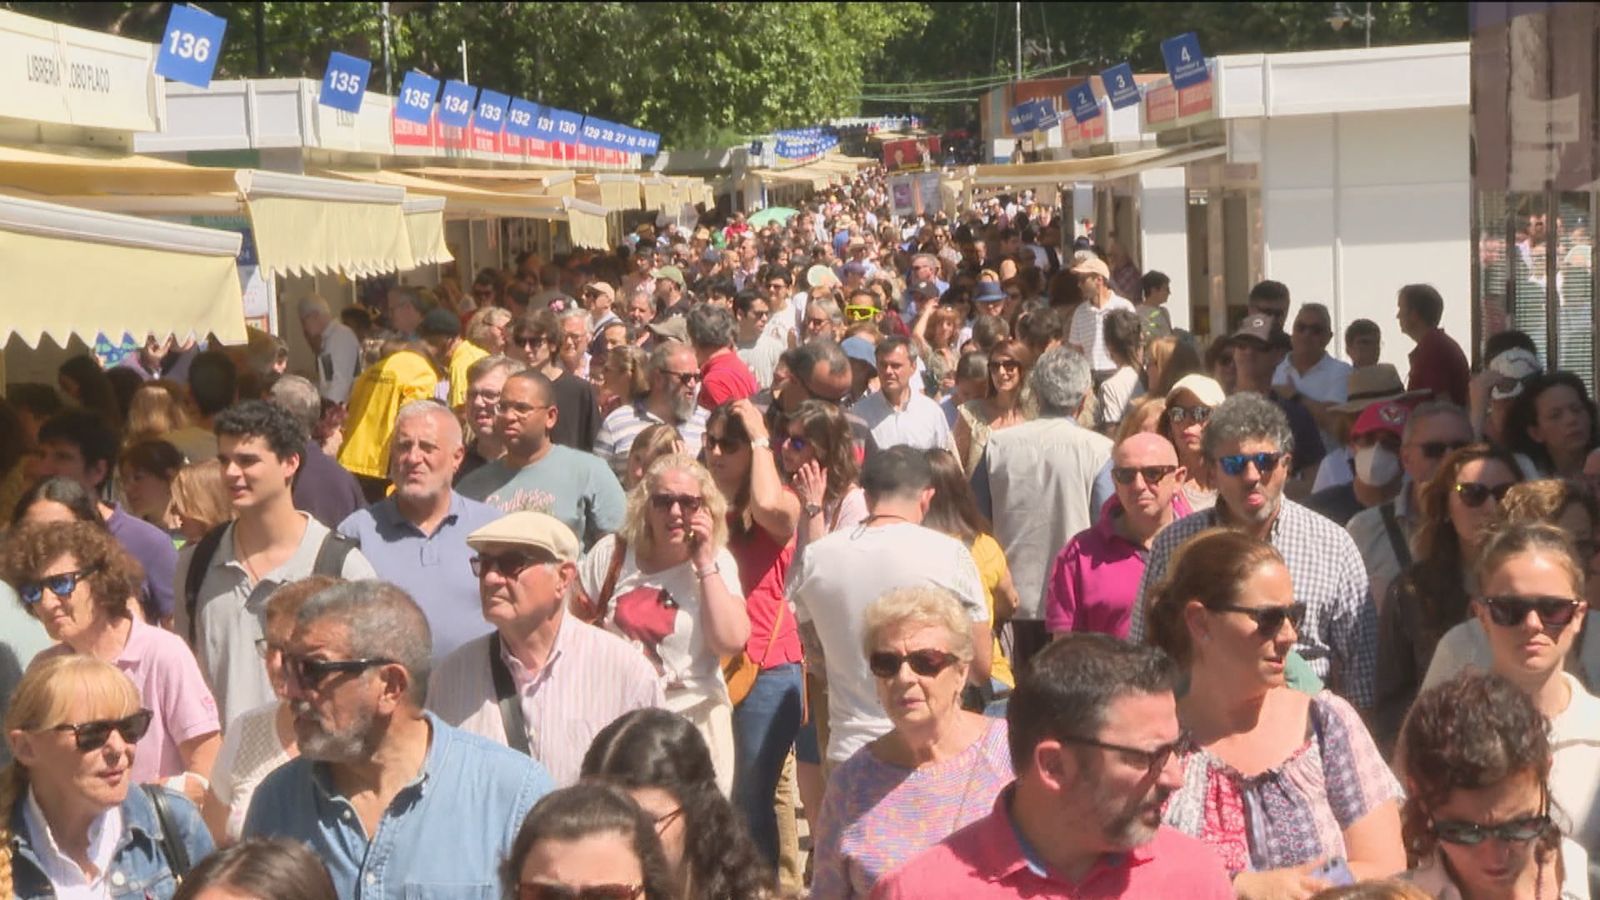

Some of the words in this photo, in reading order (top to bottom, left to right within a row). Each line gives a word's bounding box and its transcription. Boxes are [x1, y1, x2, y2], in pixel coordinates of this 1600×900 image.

[170, 29, 211, 63] 136
[1181, 46, 1191, 63] 4
[68, 62, 87, 91] OBO
[329, 69, 361, 95] 135
[1115, 74, 1126, 88] 3
[404, 86, 431, 110] 135
[444, 95, 469, 115] 134
[1077, 92, 1088, 105] 2
[479, 102, 502, 122] 133
[510, 109, 531, 127] 132
[537, 115, 554, 132] 131
[558, 119, 577, 135] 130
[584, 125, 600, 139] 129
[602, 129, 614, 142] 28
[614, 132, 626, 144] 27
